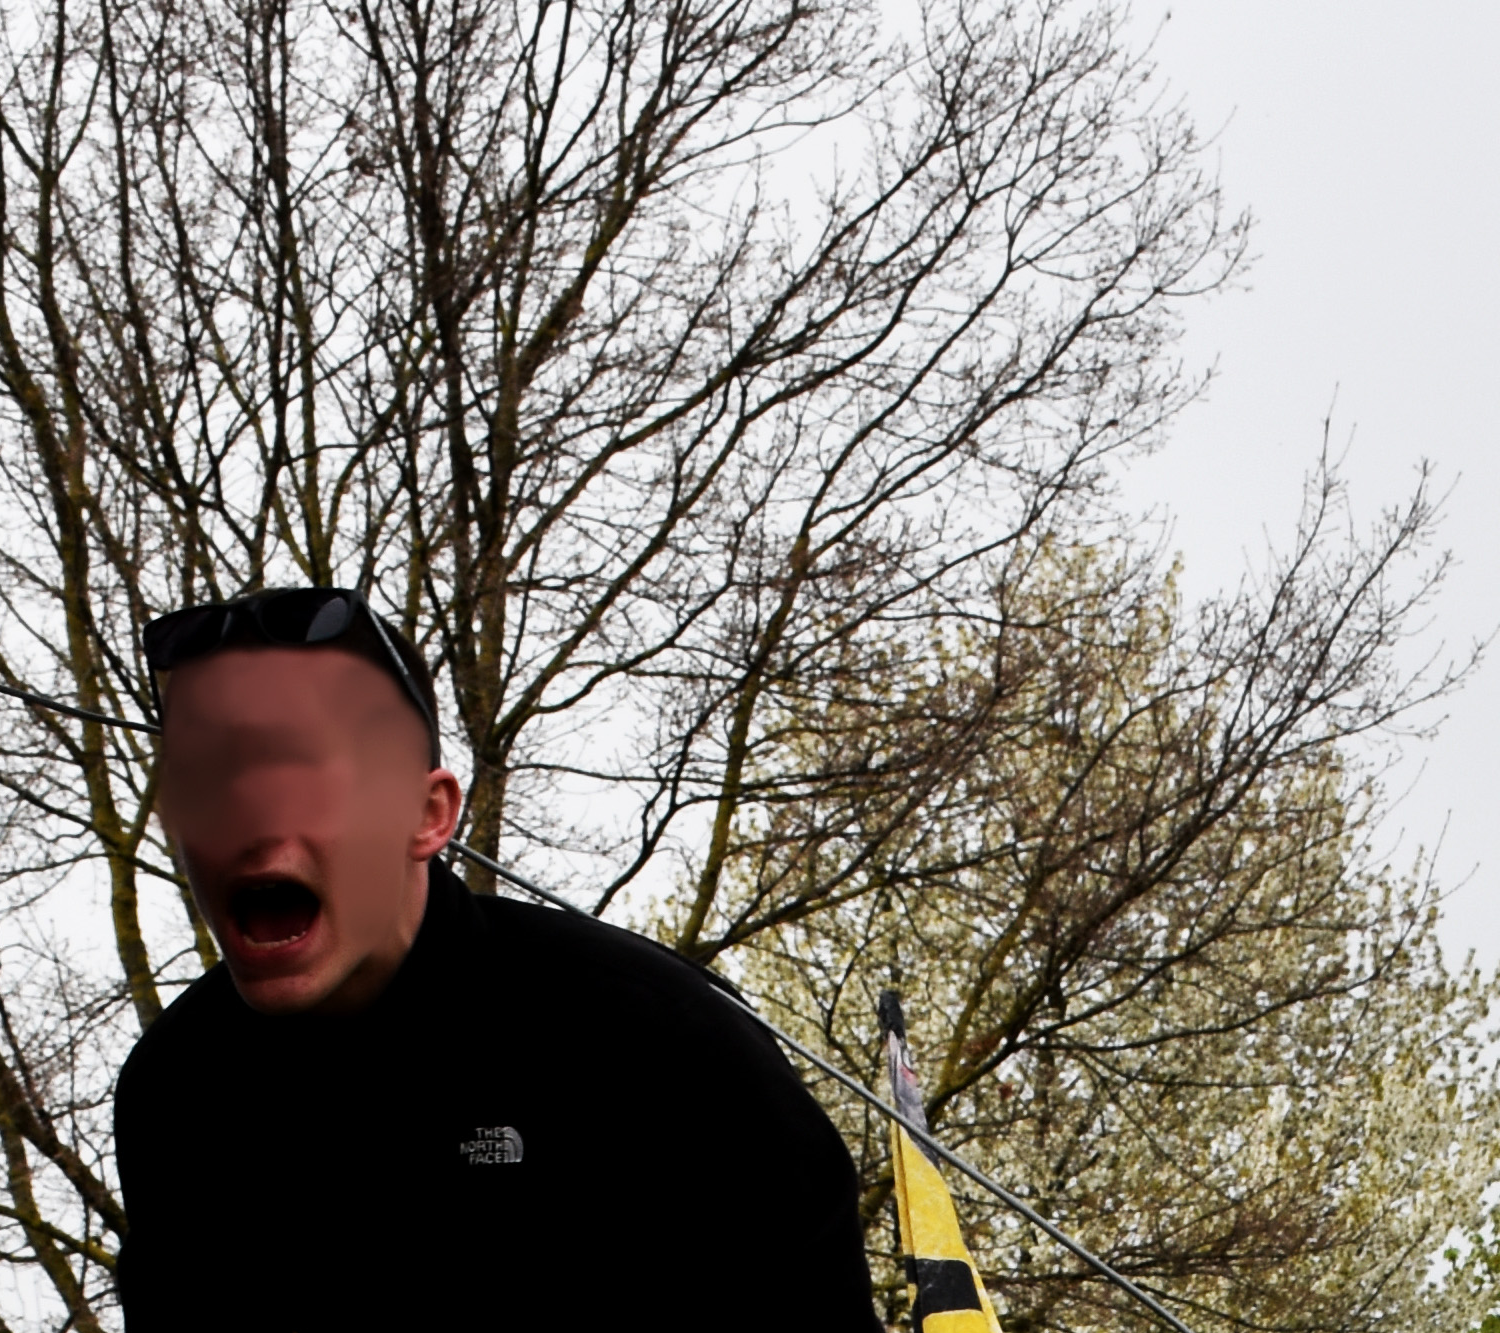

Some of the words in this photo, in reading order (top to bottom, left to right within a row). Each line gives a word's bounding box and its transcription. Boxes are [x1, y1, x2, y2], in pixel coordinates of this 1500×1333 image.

[475, 1126, 503, 1139] THE
[460, 1140, 504, 1155] NORTH
[469, 1151, 504, 1165] FACE
